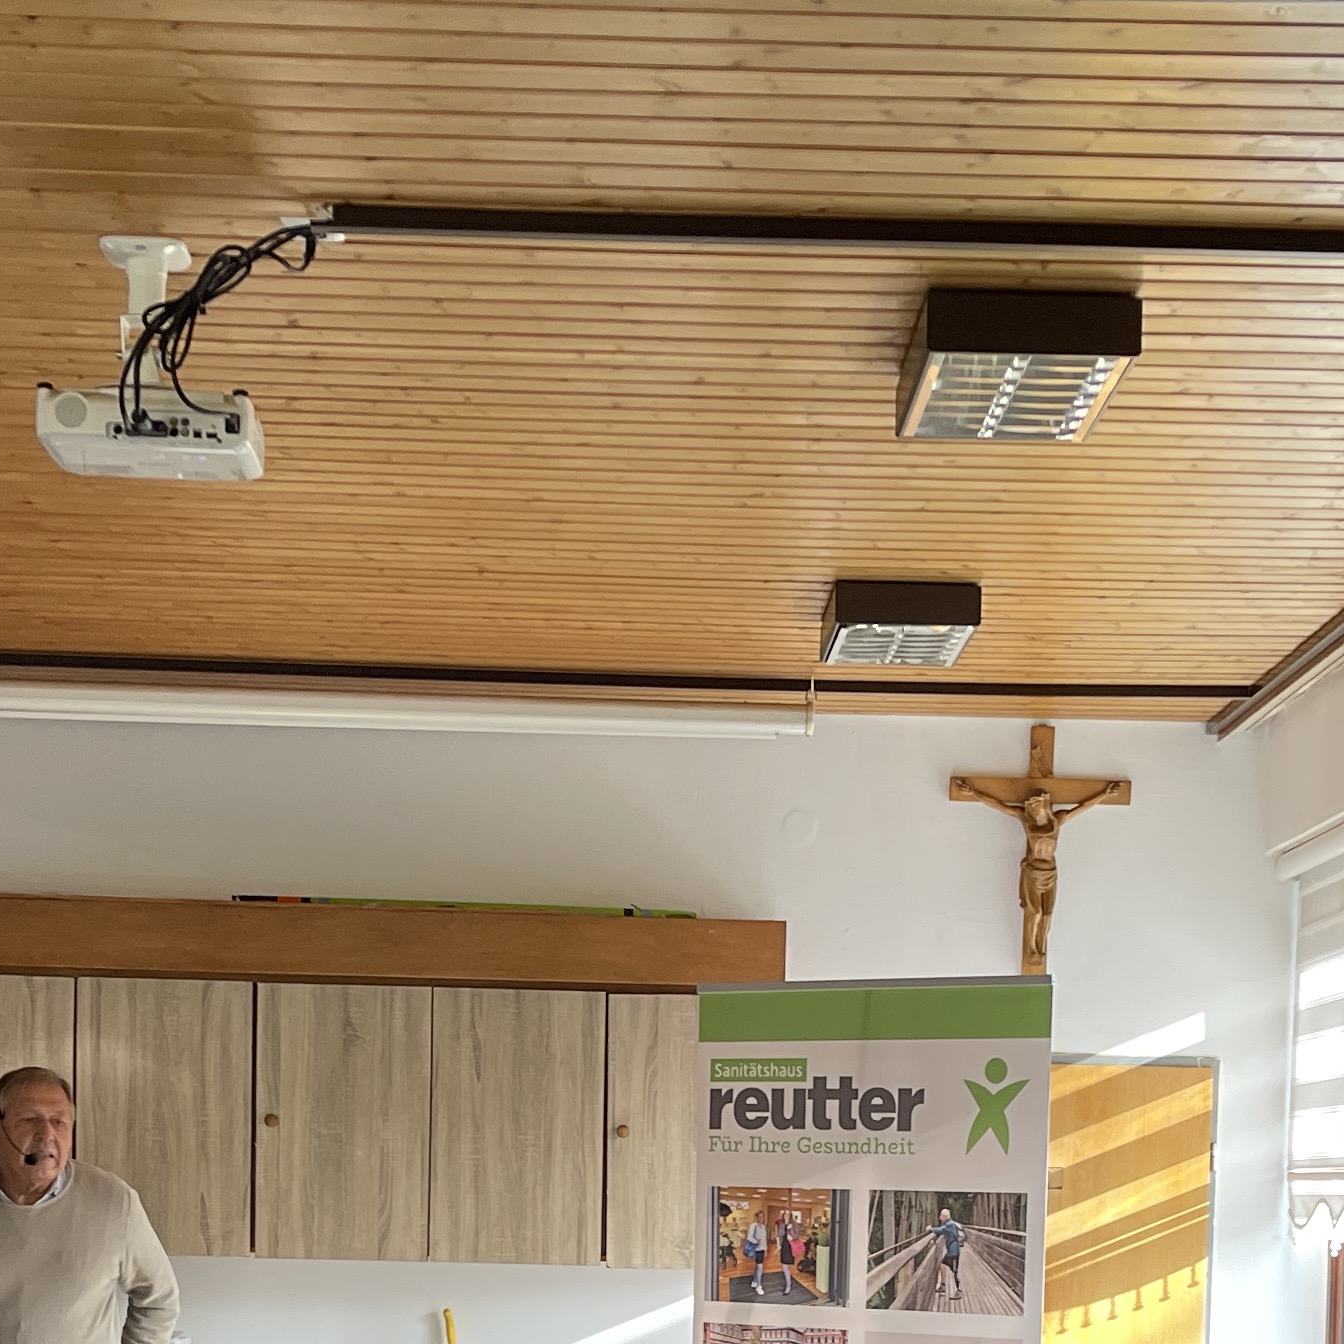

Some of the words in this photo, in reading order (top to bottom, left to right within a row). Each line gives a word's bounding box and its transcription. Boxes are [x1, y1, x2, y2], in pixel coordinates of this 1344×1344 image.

[714, 1061, 803, 1078] Sanitätshaus
[709, 1075, 925, 1132] reutter
[708, 1135, 743, 1153] Für
[748, 1135, 791, 1154] Ihre
[797, 1136, 916, 1156] Gesundheit
